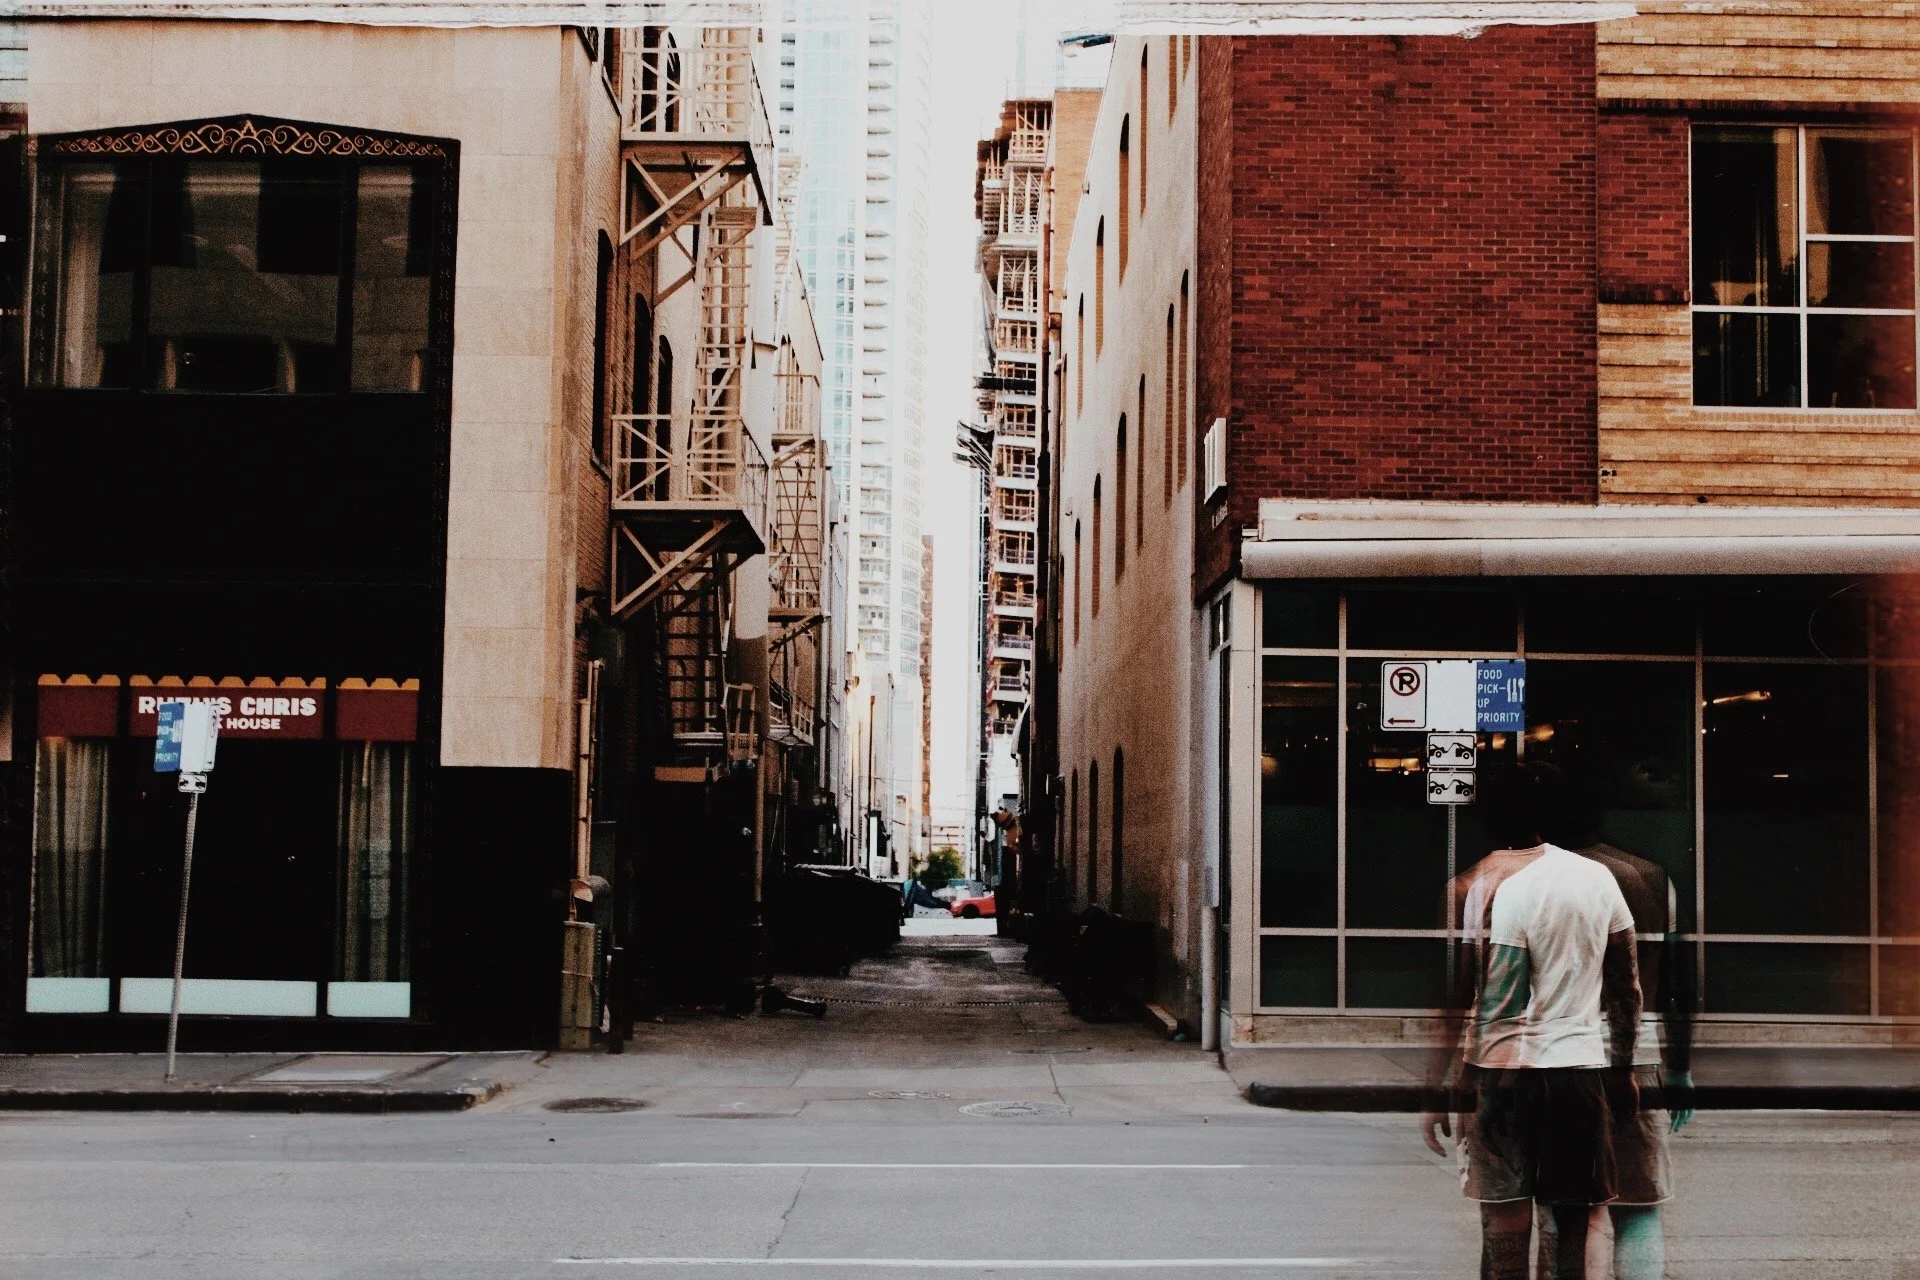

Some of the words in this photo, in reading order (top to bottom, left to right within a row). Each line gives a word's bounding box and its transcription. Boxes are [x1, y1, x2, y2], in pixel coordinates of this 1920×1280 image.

[1477, 669, 1502, 680] FOOD
[240, 696, 317, 717] CHRIS
[1477, 698, 1490, 709] UP
[1477, 711, 1520, 723] PRIORITY
[226, 717, 281, 730] HOUSE
